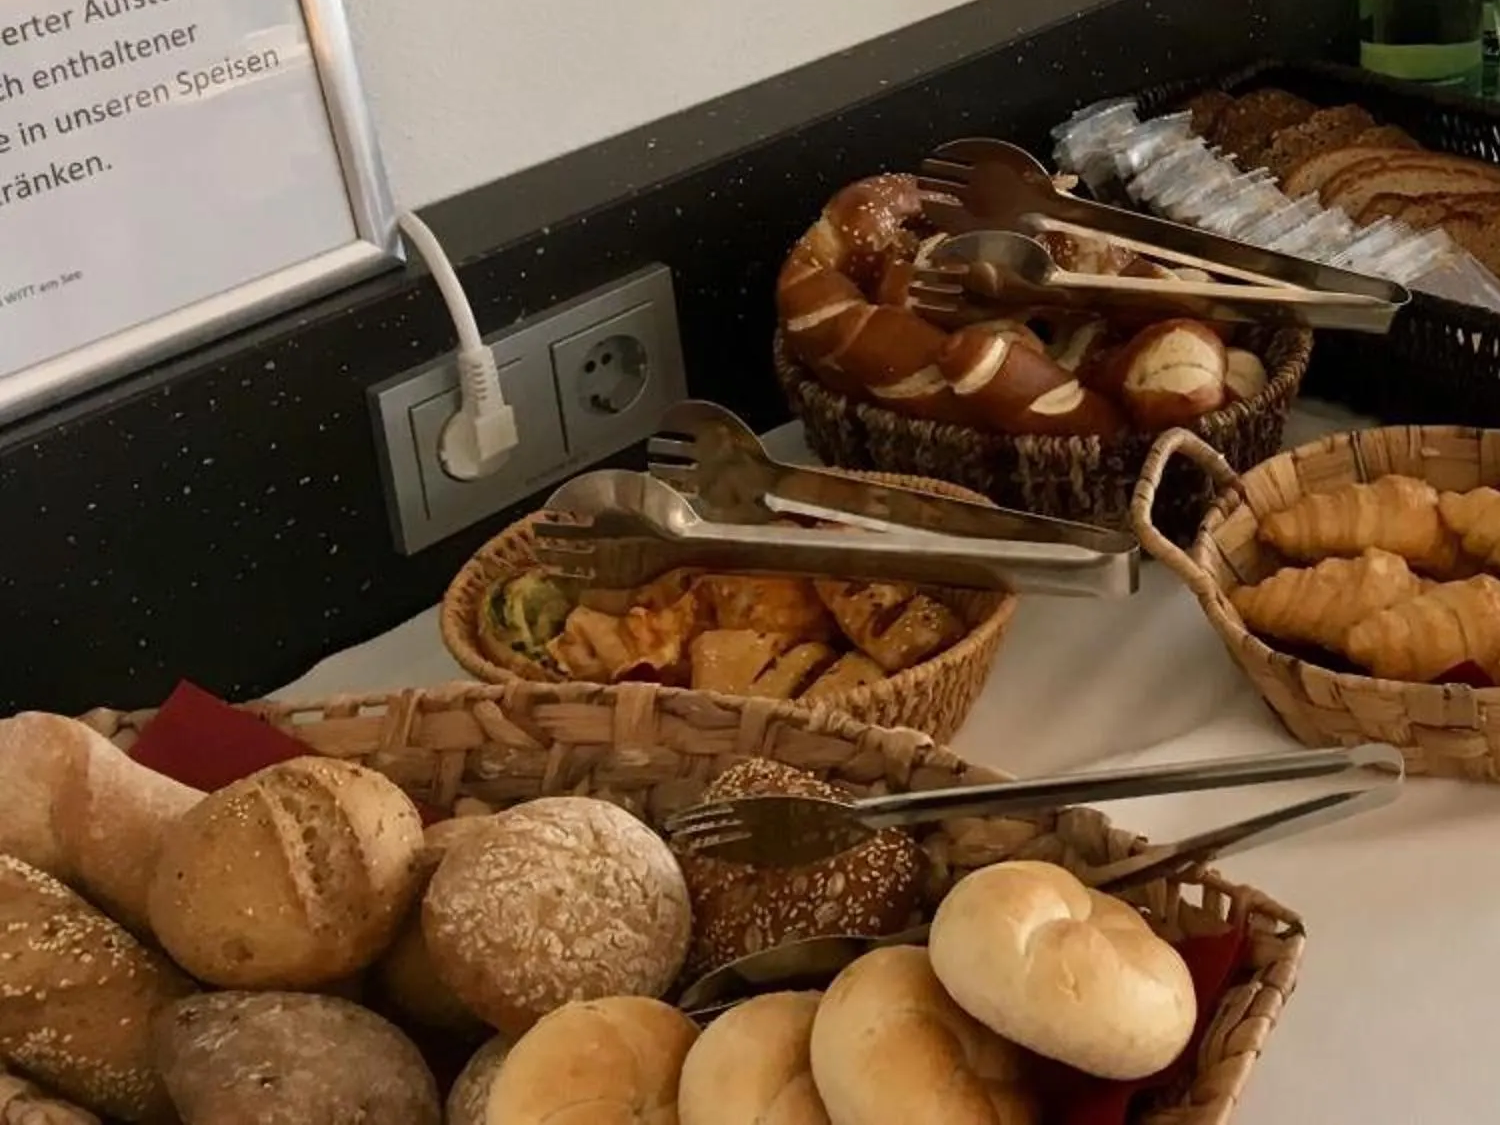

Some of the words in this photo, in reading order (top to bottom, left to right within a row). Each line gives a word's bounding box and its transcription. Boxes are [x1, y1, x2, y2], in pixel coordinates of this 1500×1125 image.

[1, 7, 75, 47] erter
[33, 24, 198, 89] enthaltener
[18, 122, 47, 147] in
[55, 83, 170, 135] unseren
[176, 49, 281, 99] Speisen
[0, 155, 114, 206] ränken.
